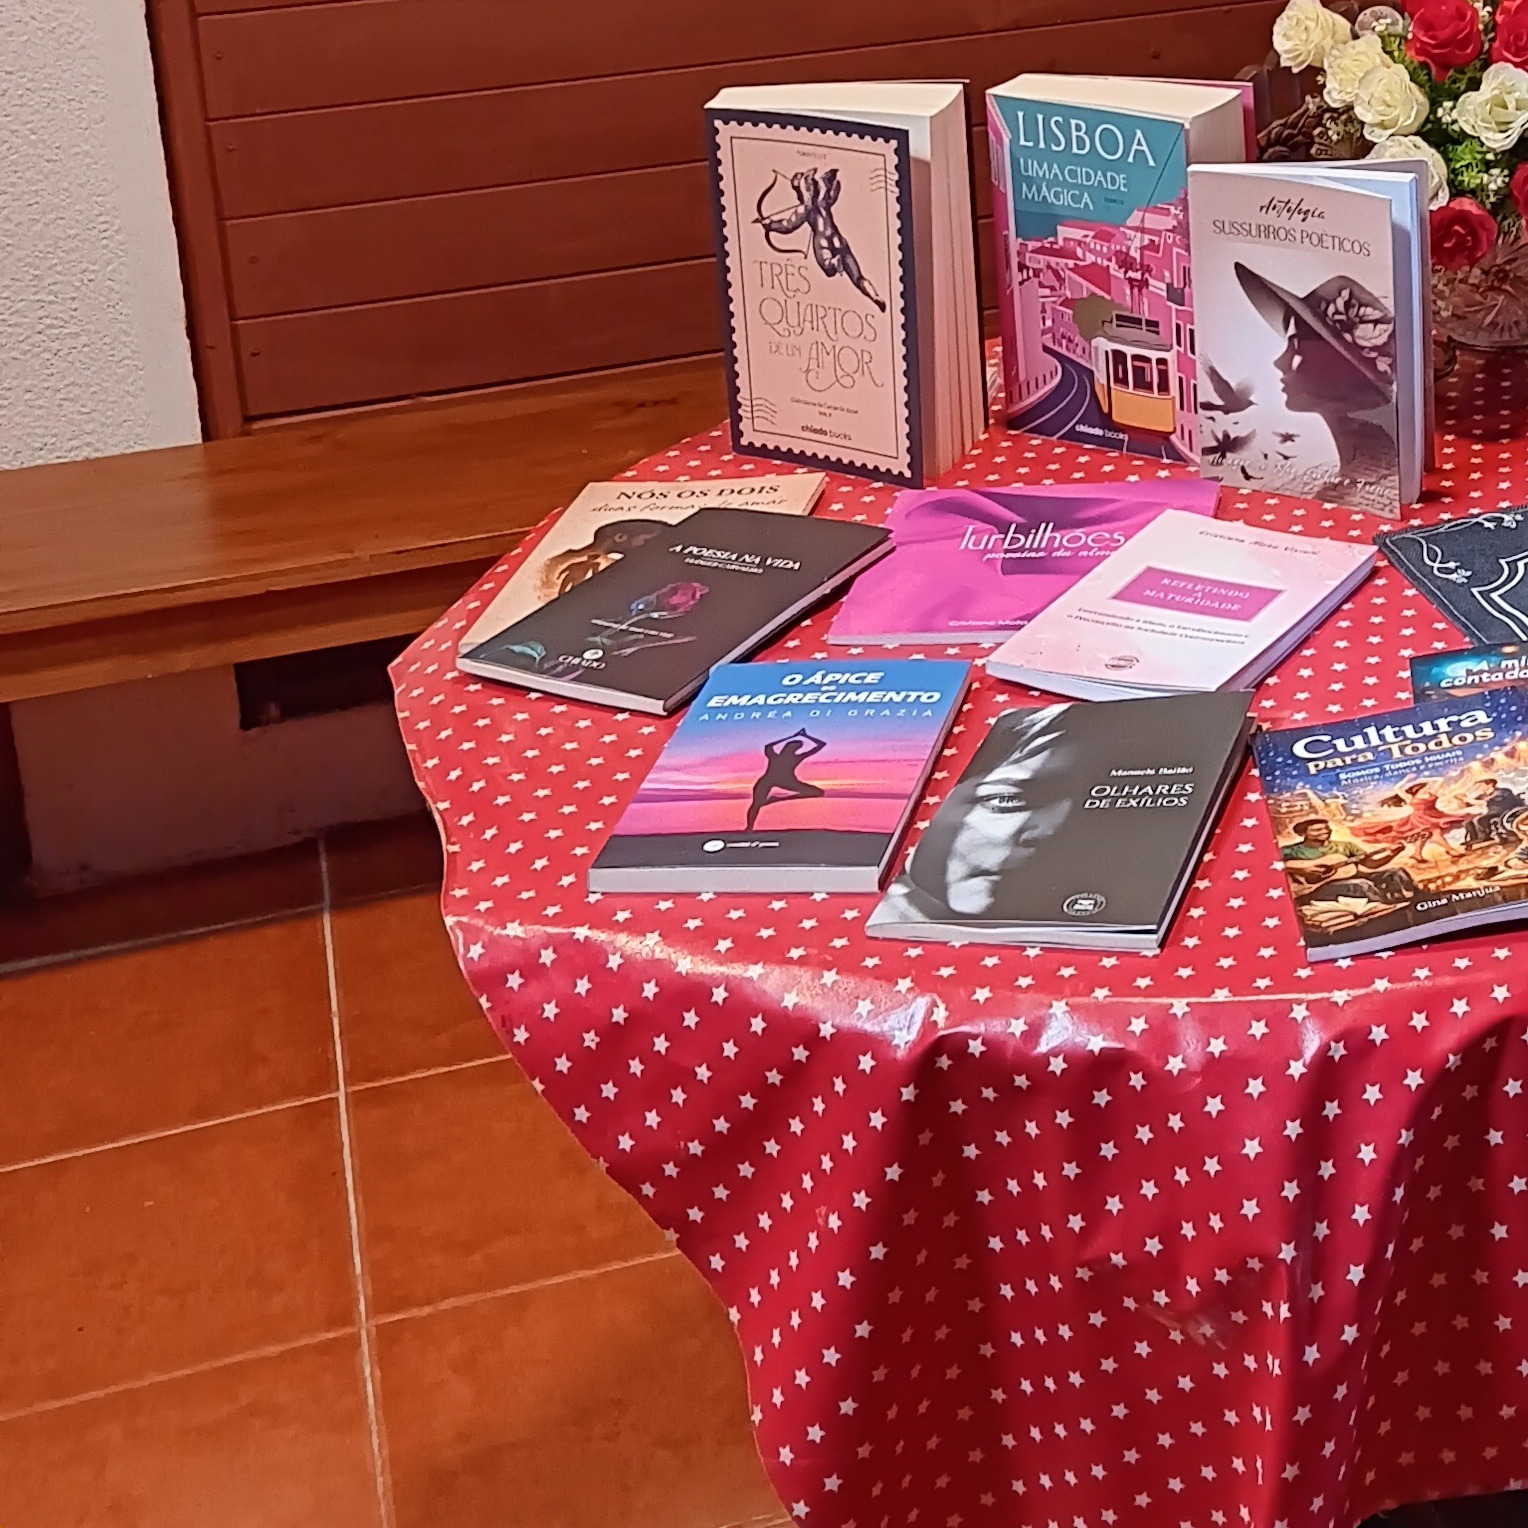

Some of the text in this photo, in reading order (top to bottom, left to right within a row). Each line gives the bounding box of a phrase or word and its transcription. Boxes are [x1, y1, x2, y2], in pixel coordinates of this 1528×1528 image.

[1016, 110, 1157, 167] LISBOA
[1019, 157, 1128, 192] UMA CIDADE
[1021, 181, 1095, 210] MÁGICA
[1212, 219, 1371, 257] SUSSURROS POÉTICOS
[754, 258, 812, 297] TRÊS
[758, 296, 878, 343] QUARTOS
[802, 341, 885, 392] AMOR
[616, 484, 781, 501] NÓS OS DOIS
[638, 501, 702, 512] forma
[683, 545, 737, 562] POESIA
[765, 556, 801, 571] VIDA
[1077, 547, 1115, 558] alm
[1143, 589, 1243, 612] MATURIDADE
[781, 670, 885, 686] O ÁPICE
[706, 691, 942, 708] EMAGRECIMENTO
[699, 709, 793, 722] ANDRÉA
[1291, 708, 1493, 760] Cultura
[1306, 727, 1495, 774] para Todos
[1083, 796, 1189, 809] DE EXÍLIOS
[1090, 783, 1195, 797] OLHARES
[1416, 884, 1502, 912] Gina Manjua
